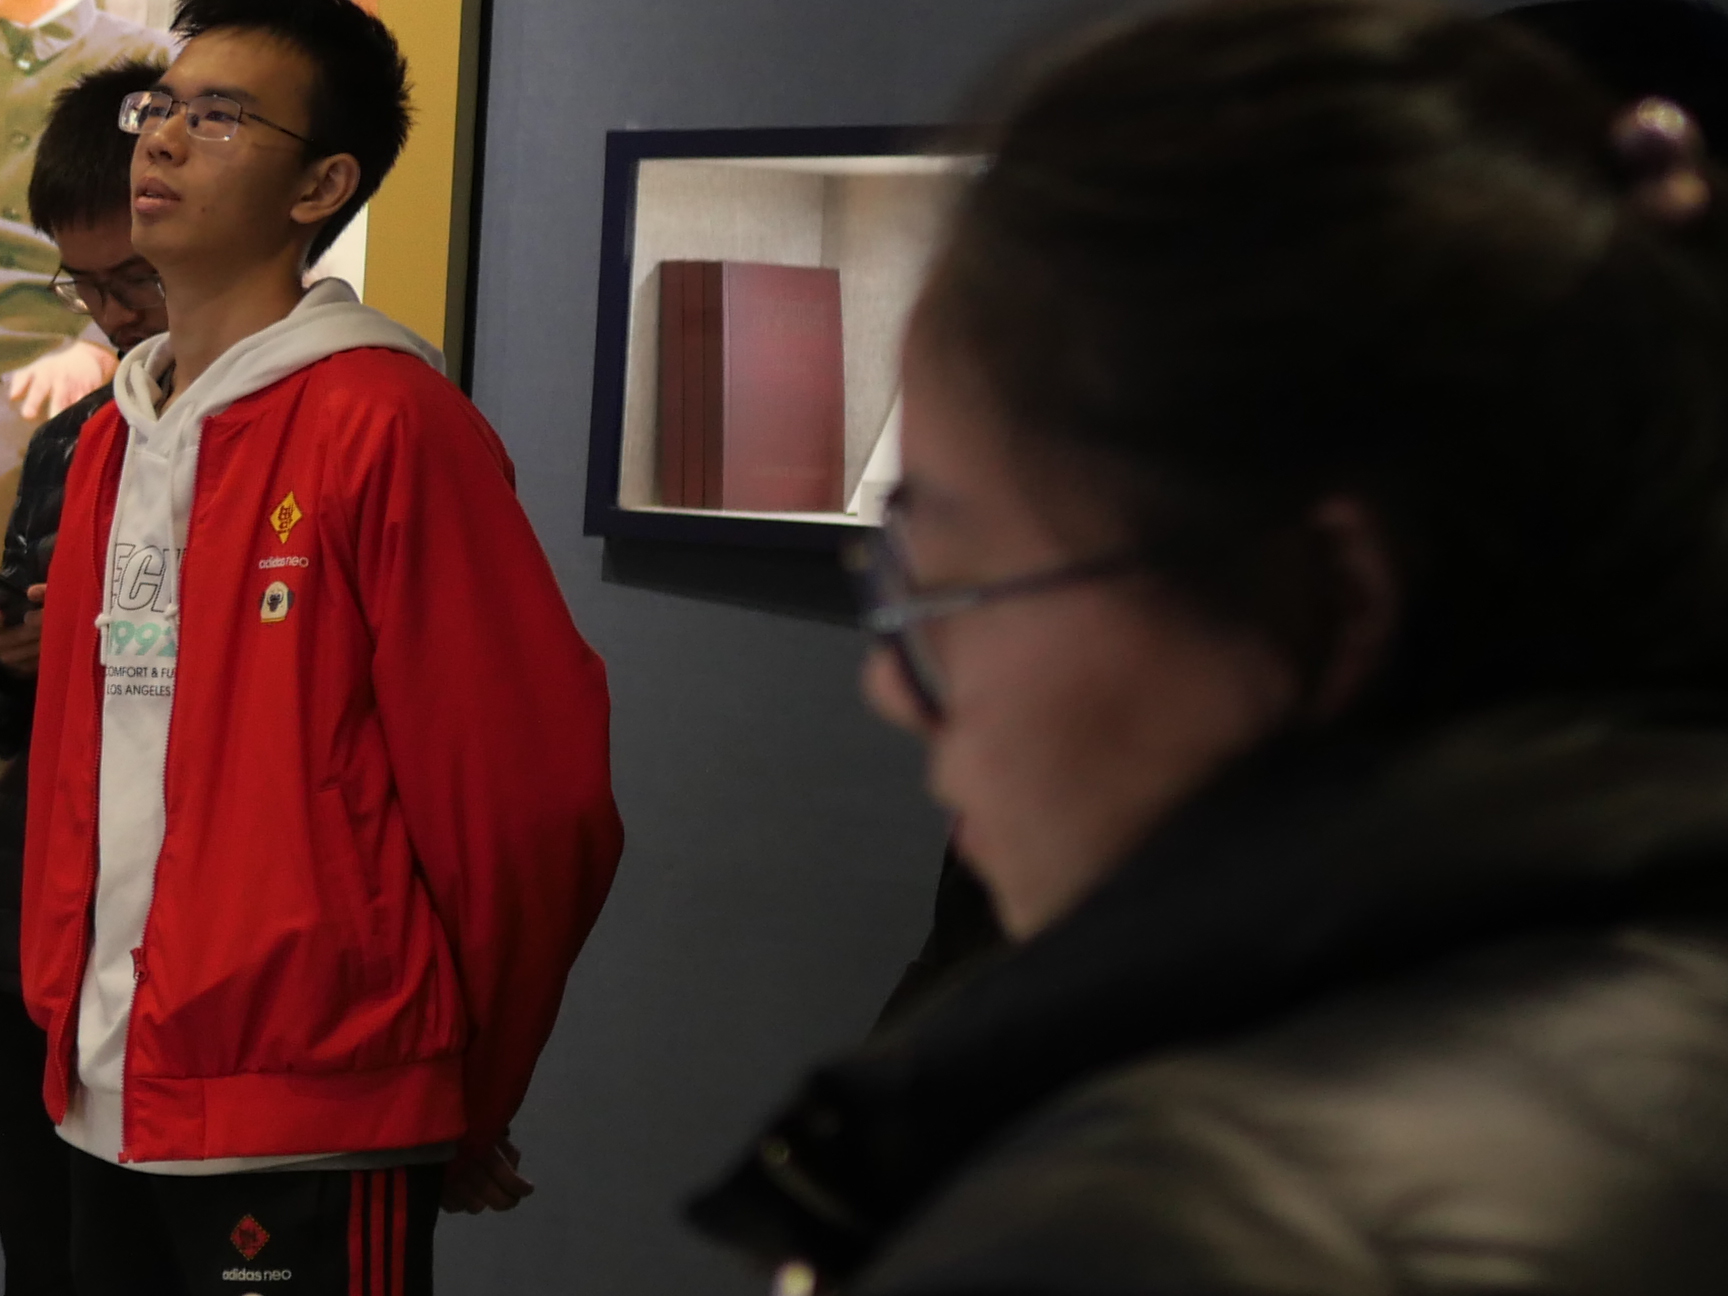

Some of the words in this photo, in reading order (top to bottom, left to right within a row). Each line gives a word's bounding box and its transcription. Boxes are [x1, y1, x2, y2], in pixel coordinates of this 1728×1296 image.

[151, 667, 158, 678] &
[107, 684, 122, 695] LOS
[125, 685, 171, 696] ANGELES
[222, 1267, 262, 1281] adidas
[263, 1269, 292, 1281] neo
